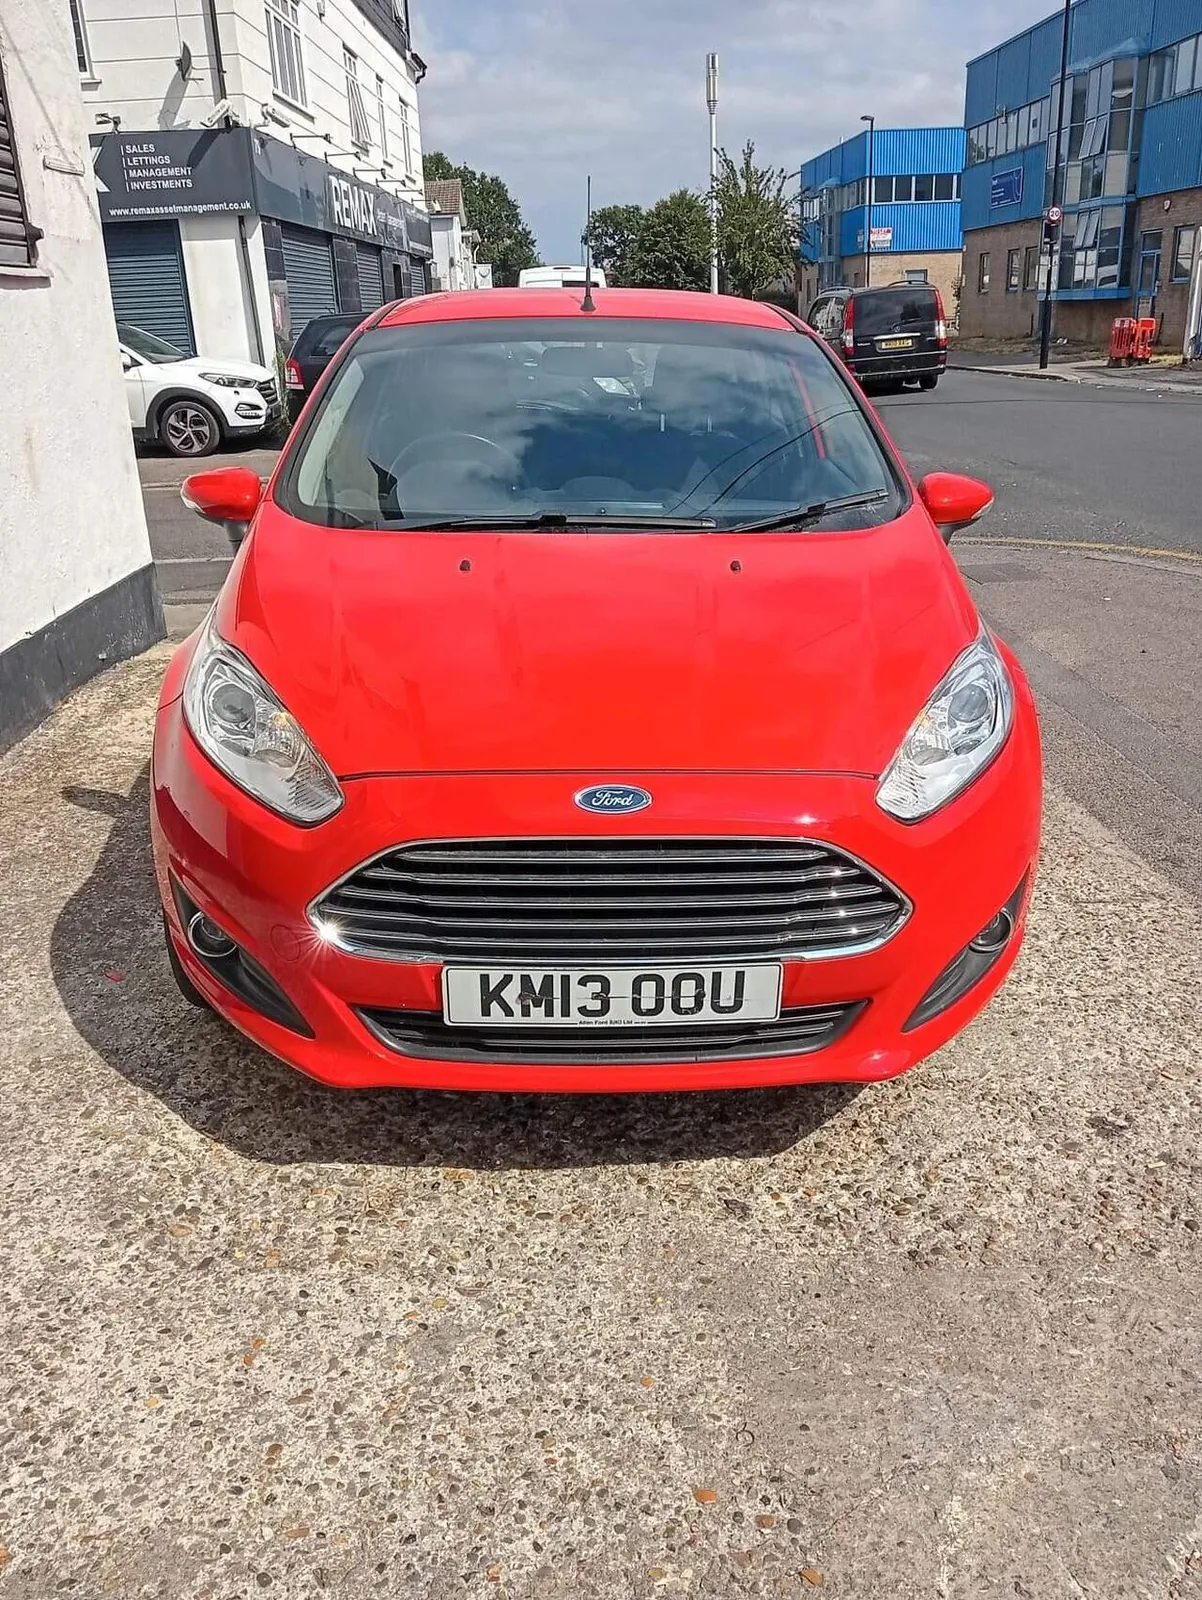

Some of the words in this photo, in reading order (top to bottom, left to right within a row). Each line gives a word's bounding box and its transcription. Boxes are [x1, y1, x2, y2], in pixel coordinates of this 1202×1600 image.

[125, 143, 156, 154] SALES
[127, 155, 171, 166] LETTINGS
[129, 166, 193, 178] MANAGEMENT
[130, 178, 193, 190] INVESTMENTS
[108, 201, 252, 217] www.remaxassetmanagement.co.uk
[329, 175, 378, 236] REMAX
[1050, 210, 1060, 218] 20
[591, 789, 634, 806] Ford
[479, 973, 611, 1018] KM13
